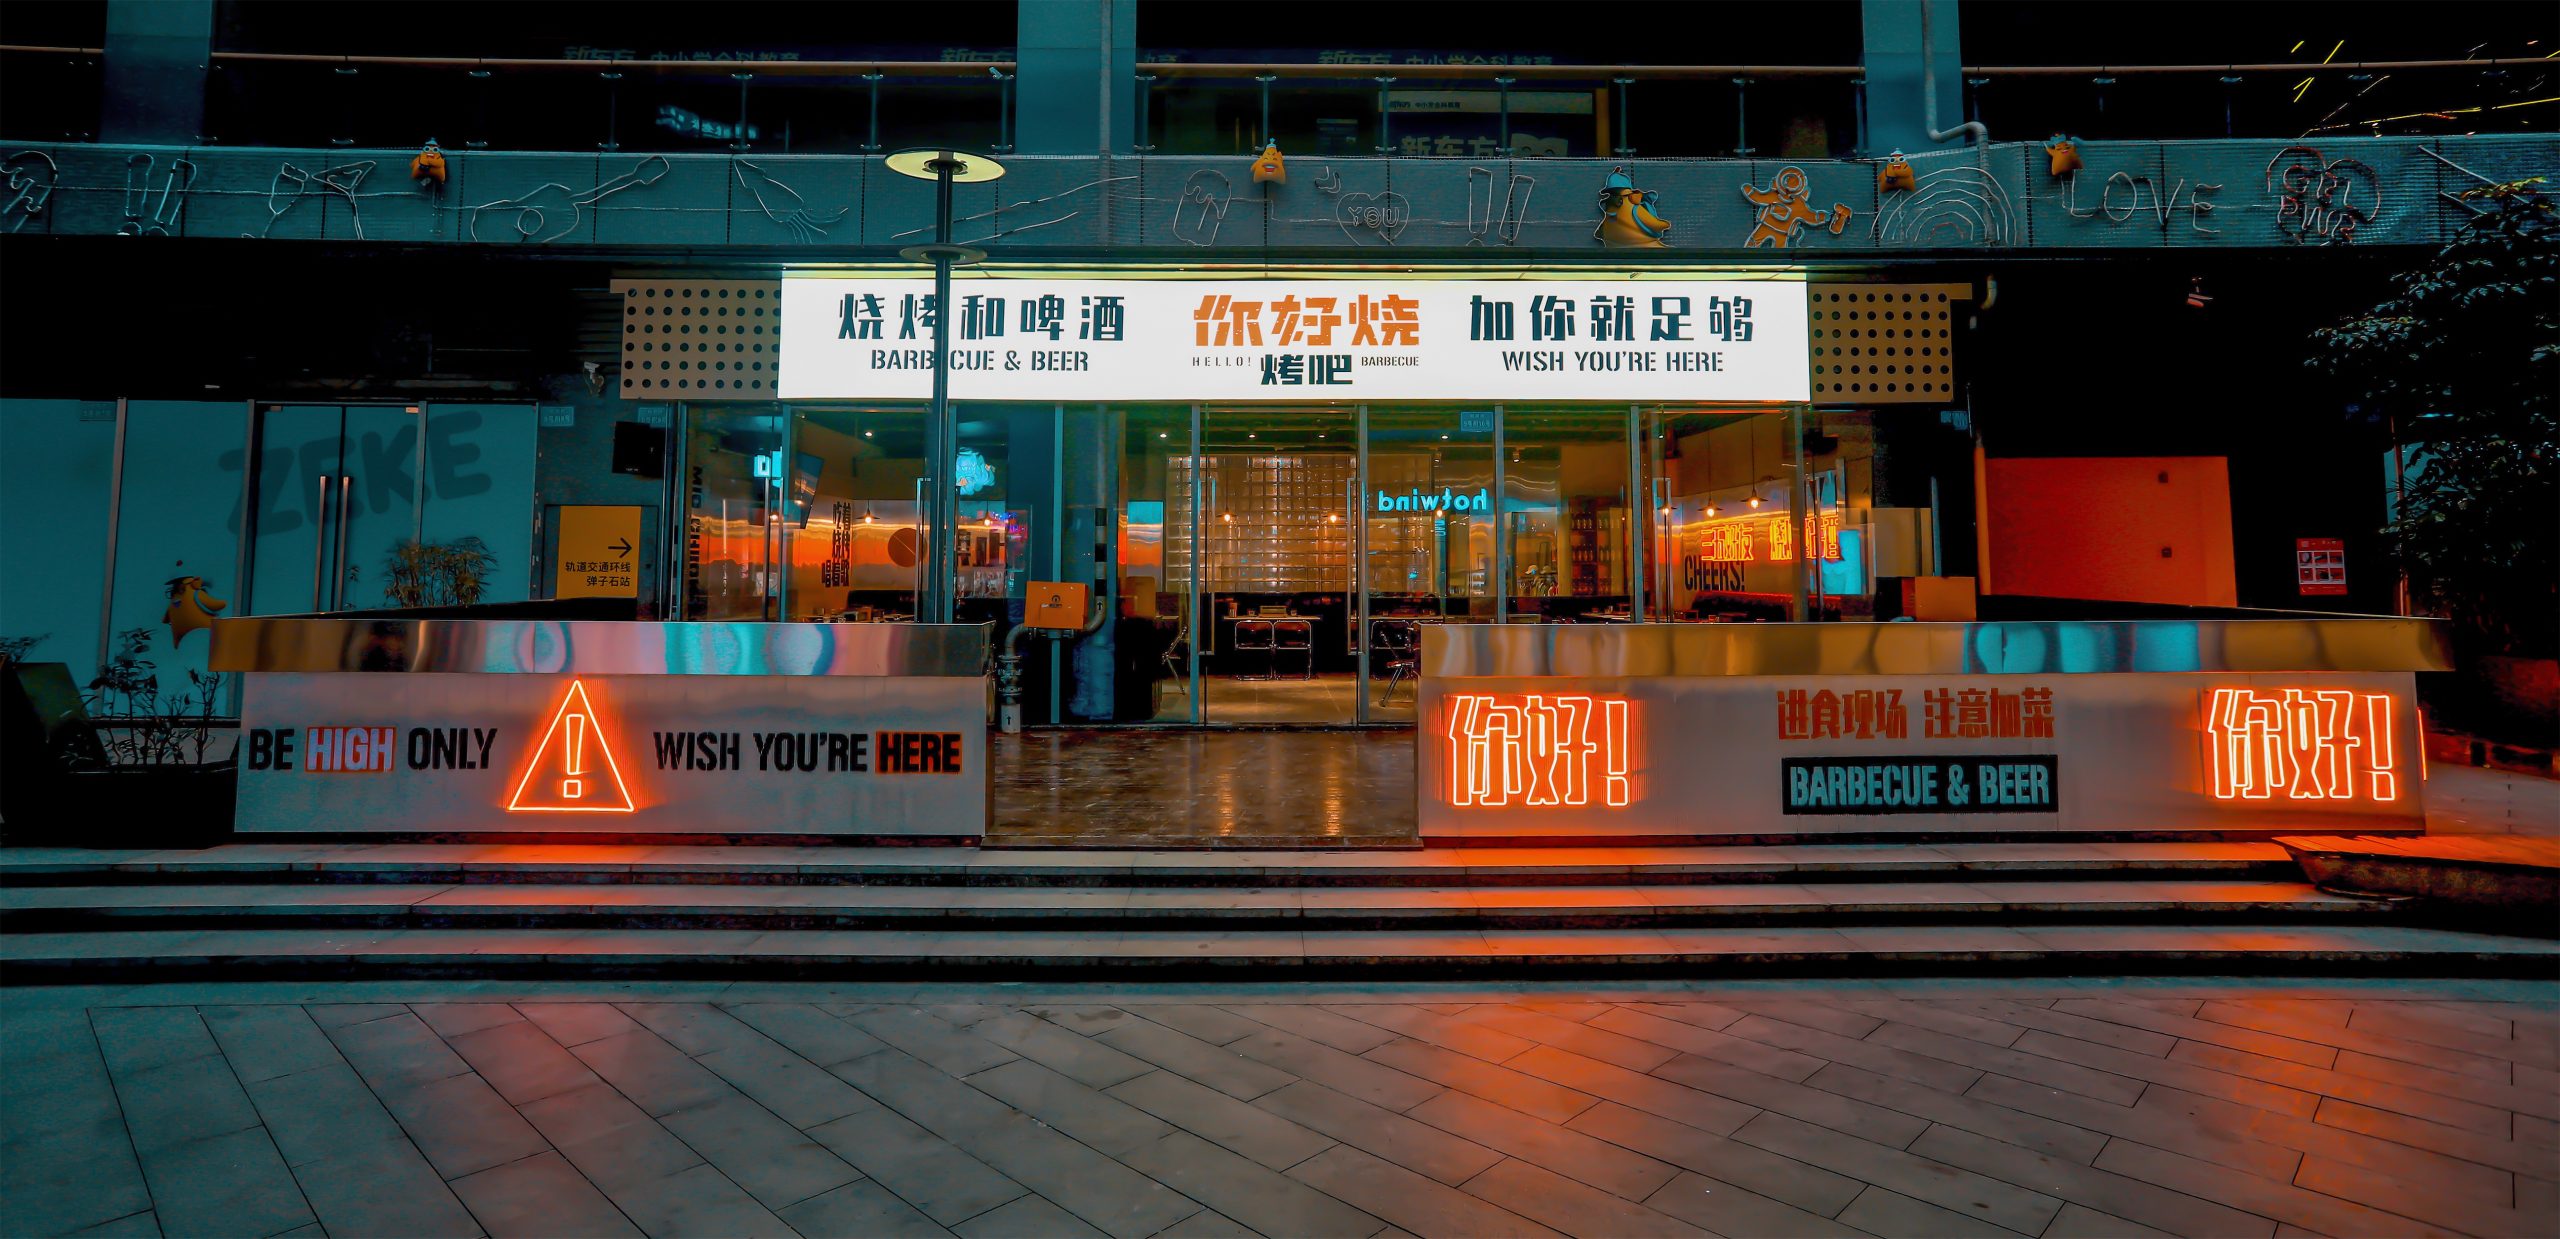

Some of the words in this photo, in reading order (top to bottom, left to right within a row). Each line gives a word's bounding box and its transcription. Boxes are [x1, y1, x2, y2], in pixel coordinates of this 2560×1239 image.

[1348, 206, 1399, 228] YOU
[2061, 170, 2224, 234] LOVE
[838, 293, 1125, 341] 烧烤和啤酒
[1194, 294, 1419, 346] 你好烧
[1470, 295, 1752, 342] 加你就足够
[871, 350, 995, 370] BARBCUE
[1004, 350, 1021, 371] &
[1031, 351, 1088, 371] BEER
[1192, 356, 1251, 367] HELLO!
[1260, 354, 1353, 385] 烤吧
[1361, 356, 1419, 367] BARBECUE
[1502, 351, 1564, 371] WISH
[1575, 351, 1656, 371] YOU'RE
[1666, 351, 1723, 372] HERE
[217, 410, 493, 537] ZEKE
[565, 561, 631, 573] 轨道交通环线
[586, 576, 631, 587] 弹子石站
[1684, 555, 1745, 592] CHEERS!
[1777, 689, 1908, 739] 进食现场
[1924, 687, 2054, 739] 注意加菜
[248, 728, 294, 770] BE
[307, 727, 394, 771] HIGH
[407, 727, 498, 770] ONLY
[653, 732, 740, 771] WISH
[753, 732, 868, 772] YOU'RE
[880, 733, 961, 773] HERE
[1790, 765, 1938, 807] BARBECUE
[1947, 764, 1970, 804] &
[1978, 764, 2050, 804] BEER
